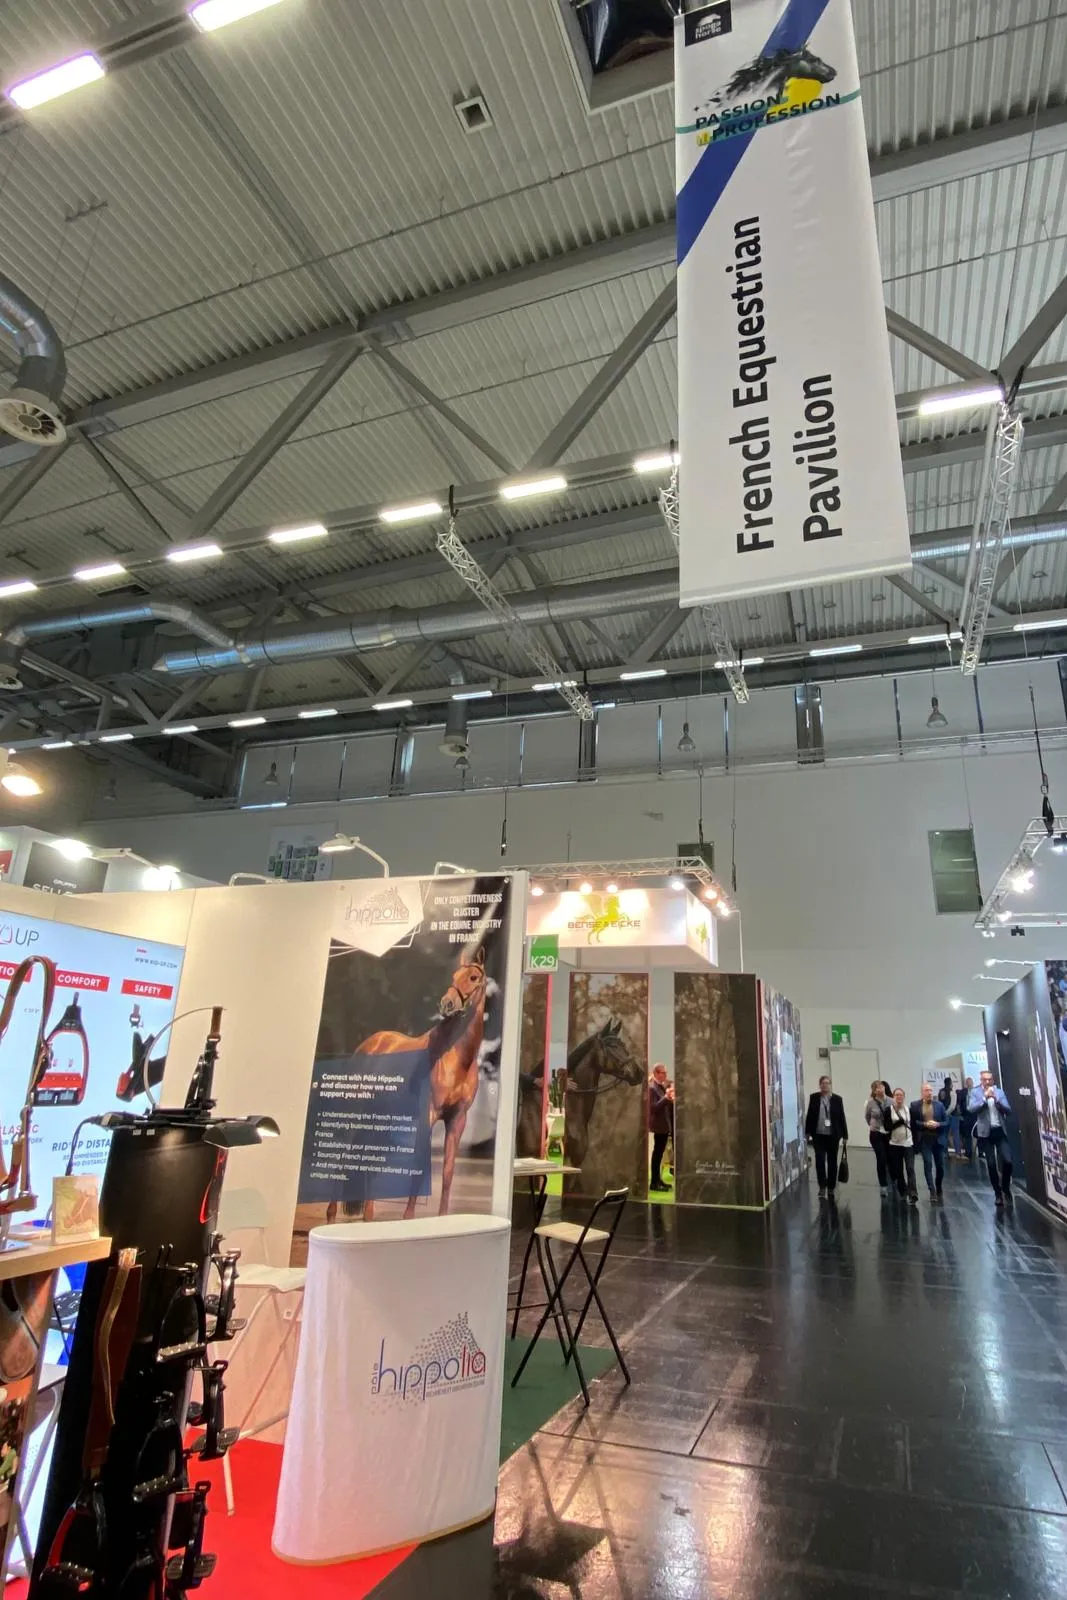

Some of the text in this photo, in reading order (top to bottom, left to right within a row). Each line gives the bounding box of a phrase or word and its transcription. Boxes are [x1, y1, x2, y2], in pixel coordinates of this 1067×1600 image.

[695, 93, 781, 129] PASSION
[712, 93, 840, 141] PROFESSION
[725, 216, 777, 554] French Equestrian
[792, 374, 843, 542] Pavilion
[434, 896, 448, 905] ONLY
[453, 907, 480, 917] CLUSTER
[430, 921, 438, 931] IN
[438, 920, 449, 930] THE
[449, 920, 472, 930] EQUINE
[610, 920, 641, 928] EICKE
[448, 933, 481, 944] IN FRANCE
[531, 955, 555, 969] K29
[57, 973, 102, 988] COMFORT
[134, 983, 162, 996] SAFETY
[322, 1073, 348, 1081] Connect
[377, 1075, 404, 1083] Hippolia
[334, 1082, 359, 1090] discover
[345, 1092, 357, 1100] you
[322, 1111, 413, 1122] Understanding the French market
[350, 1122, 373, 1130] business
[373, 1124, 411, 1132] opportunities
[314, 1130, 334, 1138] France
[318, 1141, 351, 1151] Establishing
[351, 1144, 364, 1152] your
[364, 1144, 389, 1153] presence
[396, 1145, 415, 1153] France
[317, 1151, 386, 1162] Sourcing French products
